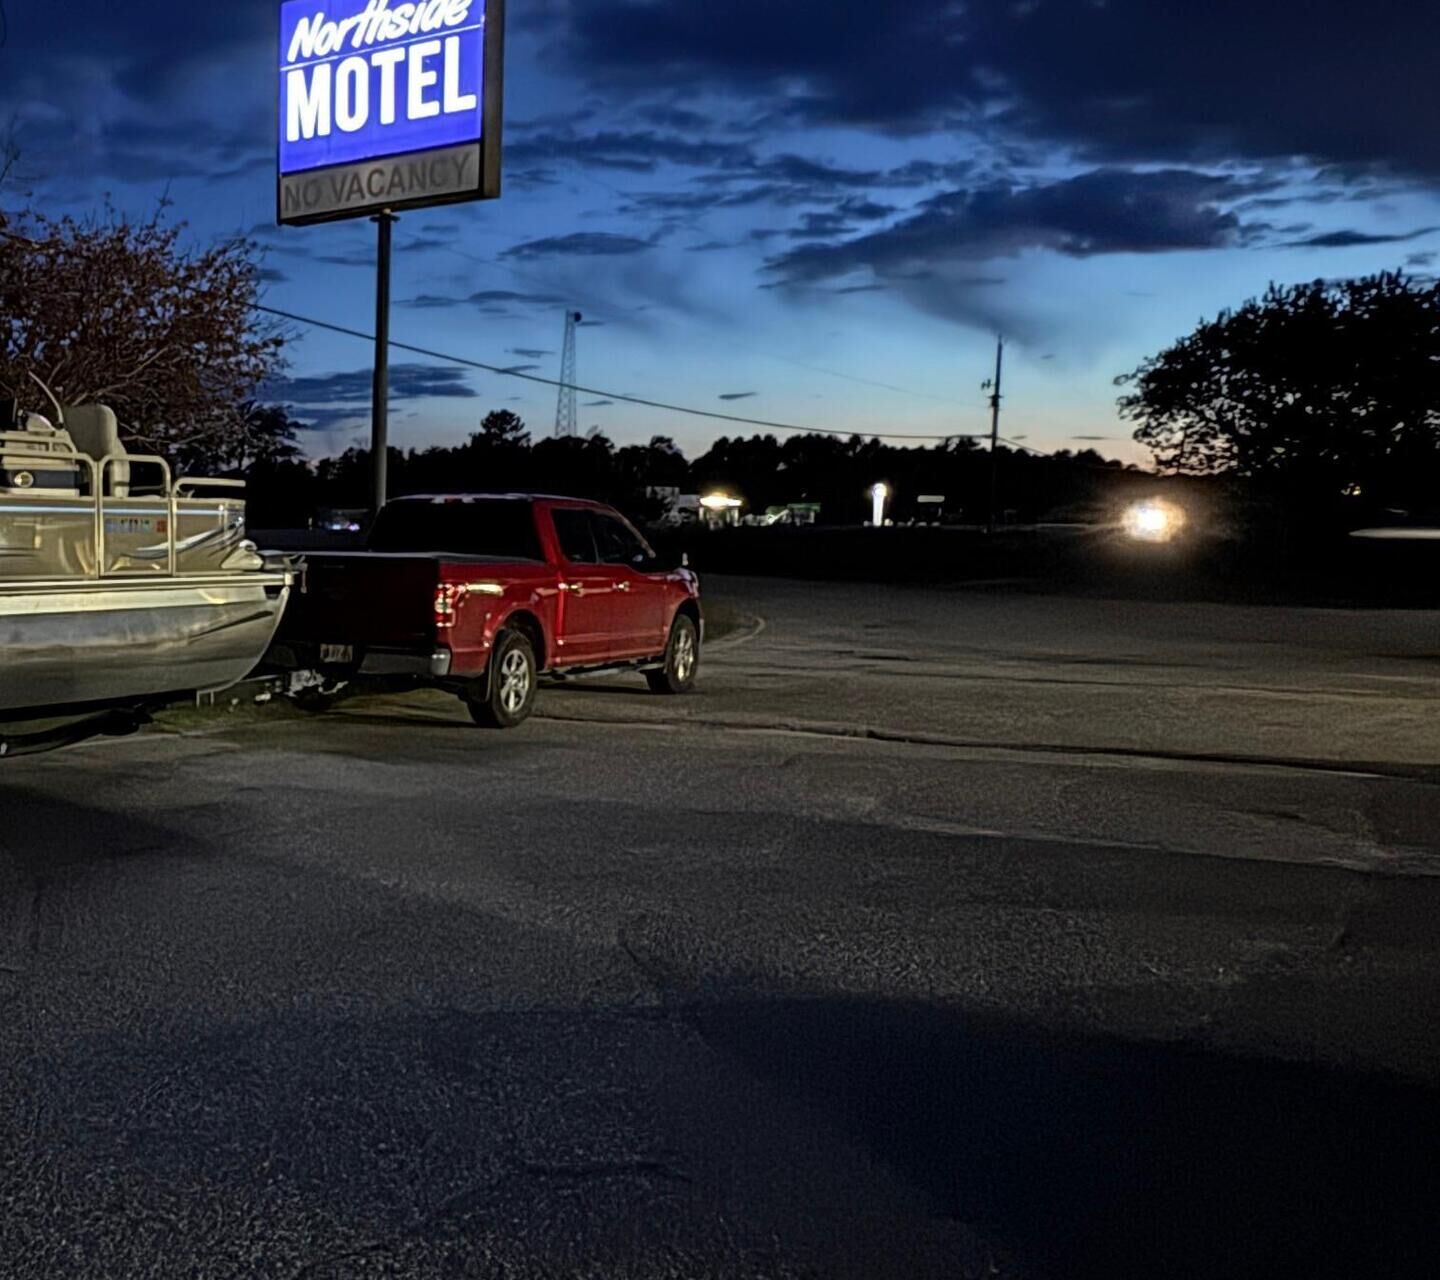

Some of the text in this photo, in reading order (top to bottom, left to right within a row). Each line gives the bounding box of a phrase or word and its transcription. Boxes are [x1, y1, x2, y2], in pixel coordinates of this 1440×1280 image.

[286, 35, 477, 142] MOTEL
[283, 151, 474, 212] NO VACANCY
